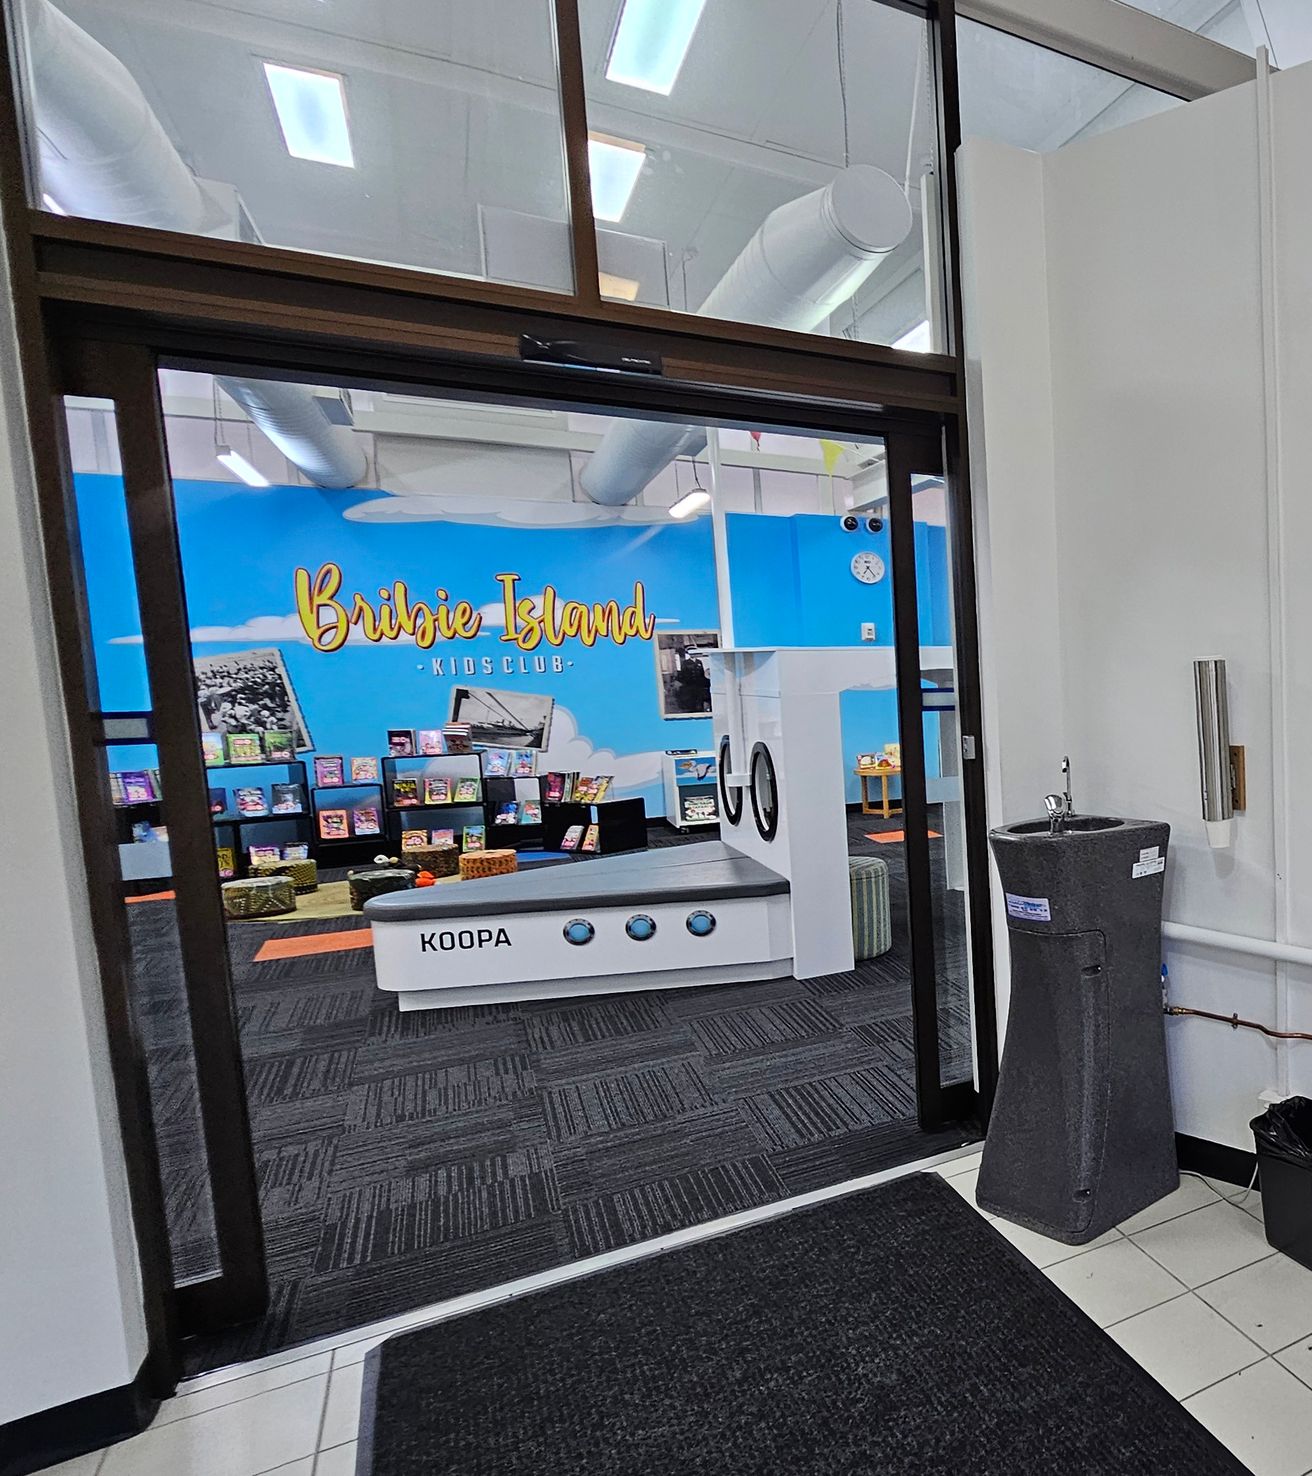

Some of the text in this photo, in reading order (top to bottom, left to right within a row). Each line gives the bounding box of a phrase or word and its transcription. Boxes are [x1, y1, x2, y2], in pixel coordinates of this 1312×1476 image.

[294, 562, 655, 652] Bribie Island
[432, 655, 564, 676] KIDS CLUB
[420, 927, 512, 952] KOOPA
